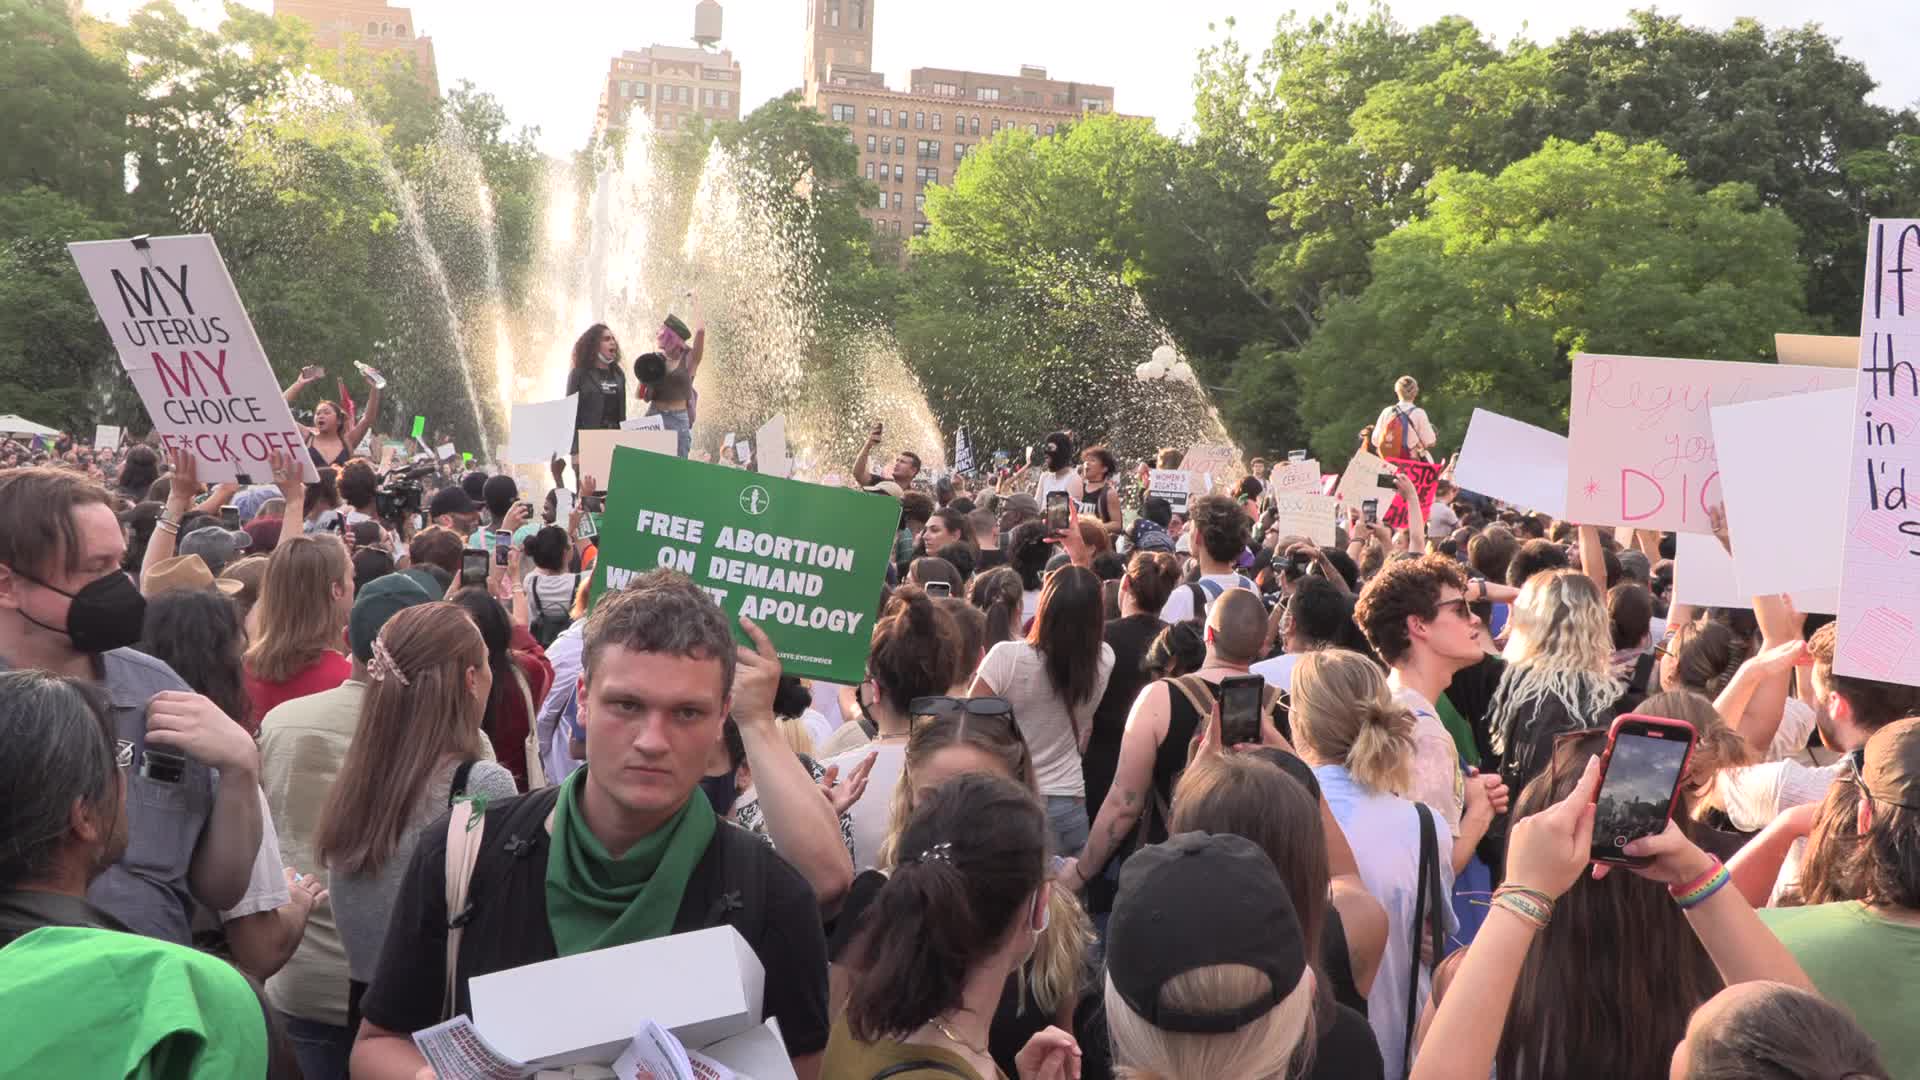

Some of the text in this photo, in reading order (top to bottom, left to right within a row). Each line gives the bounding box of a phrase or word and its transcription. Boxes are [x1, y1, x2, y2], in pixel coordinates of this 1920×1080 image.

[110, 264, 195, 319] MY
[122, 316, 230, 347] UTERUS
[151, 349, 232, 398] MY
[1863, 332, 1919, 400] th
[163, 397, 267, 425] CHOICE
[1865, 410, 1895, 446] in
[241, 430, 301, 463] OFF
[1622, 468, 1720, 523] DIC
[1867, 458, 1908, 511] I'd
[636, 509, 704, 544] FREE
[714, 526, 855, 572] ABORTION
[657, 546, 696, 575] ON
[708, 556, 823, 598] DEMAND
[738, 595, 864, 634] APOLOGY
